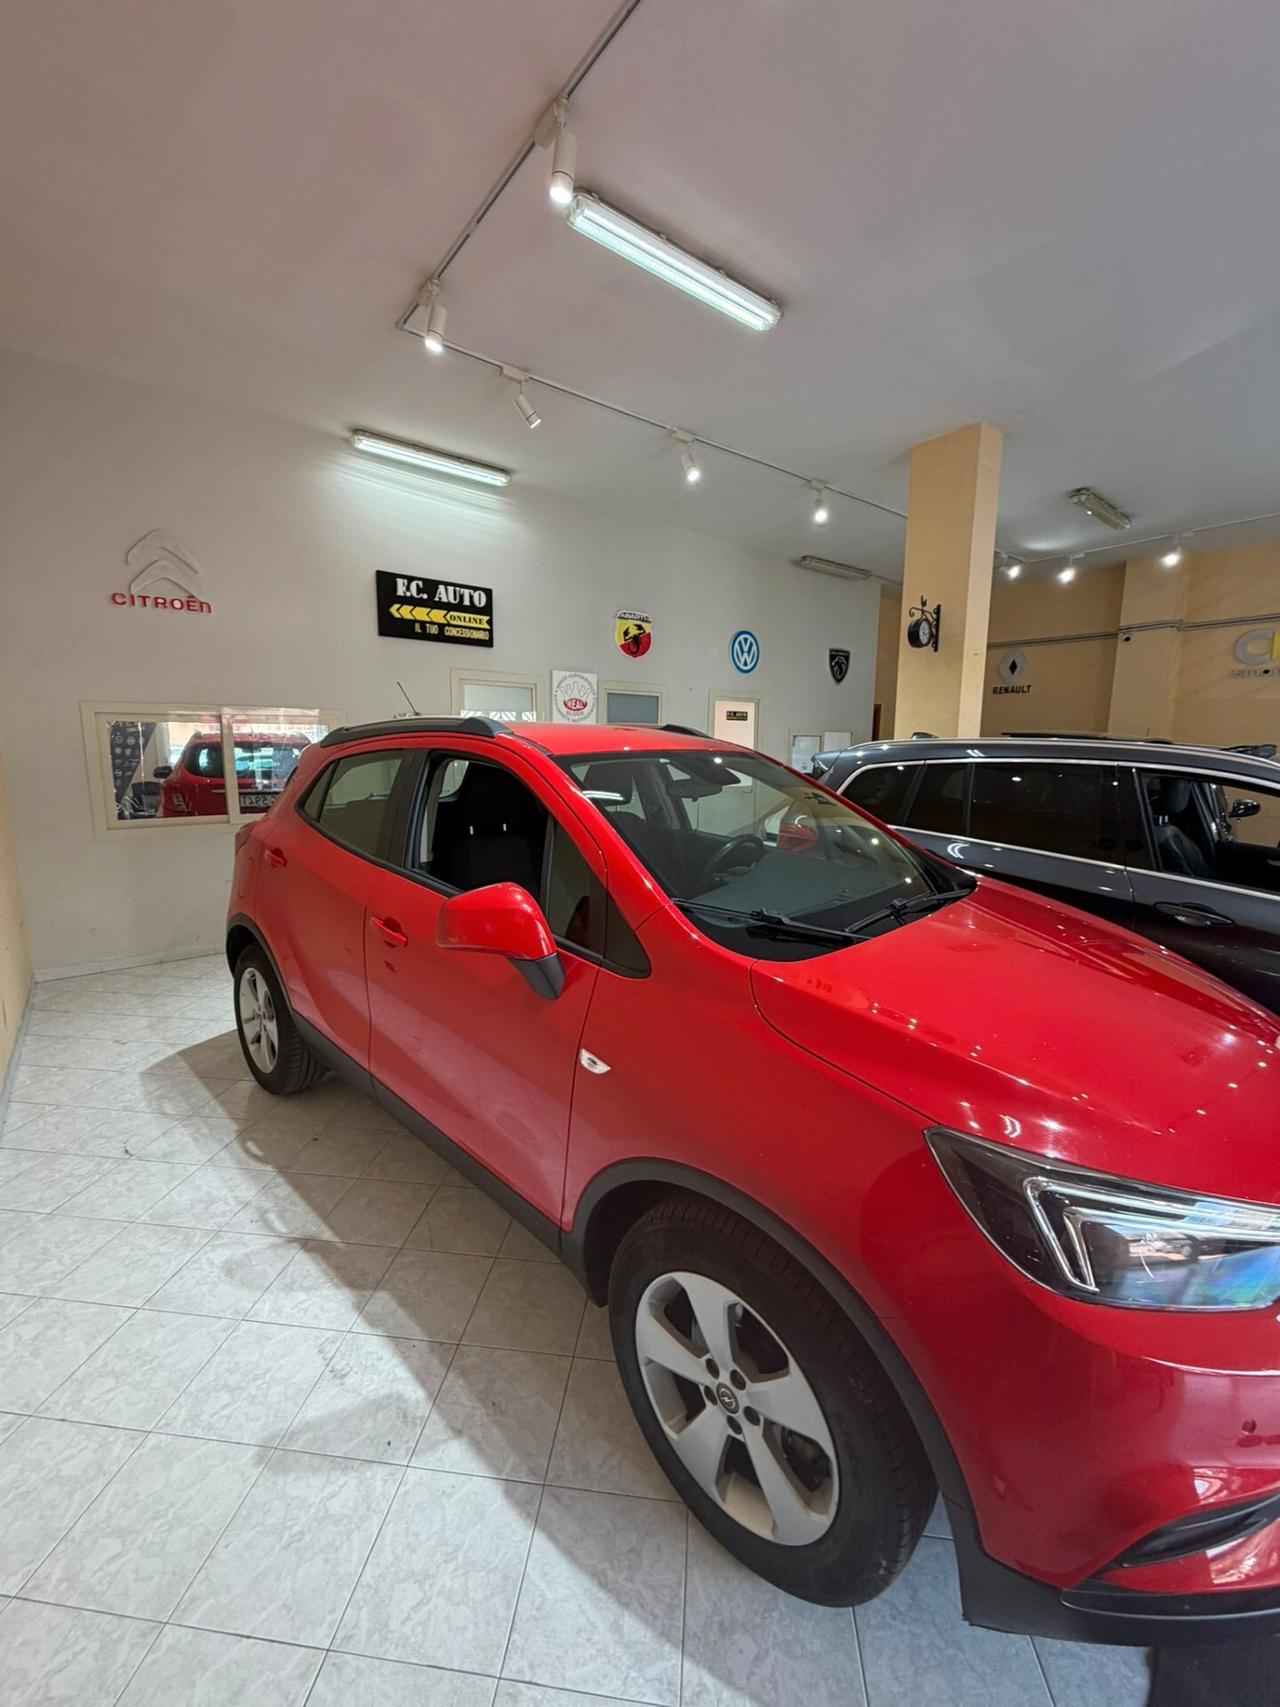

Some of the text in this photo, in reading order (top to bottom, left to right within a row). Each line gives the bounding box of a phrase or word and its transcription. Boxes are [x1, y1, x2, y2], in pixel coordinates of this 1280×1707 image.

[395, 578, 487, 608] F.C. AUTO
[449, 613, 486, 626] ONLINE
[414, 622, 490, 640] IL TUO CONCESSIONARIO
[992, 684, 1032, 695] RENAULT
